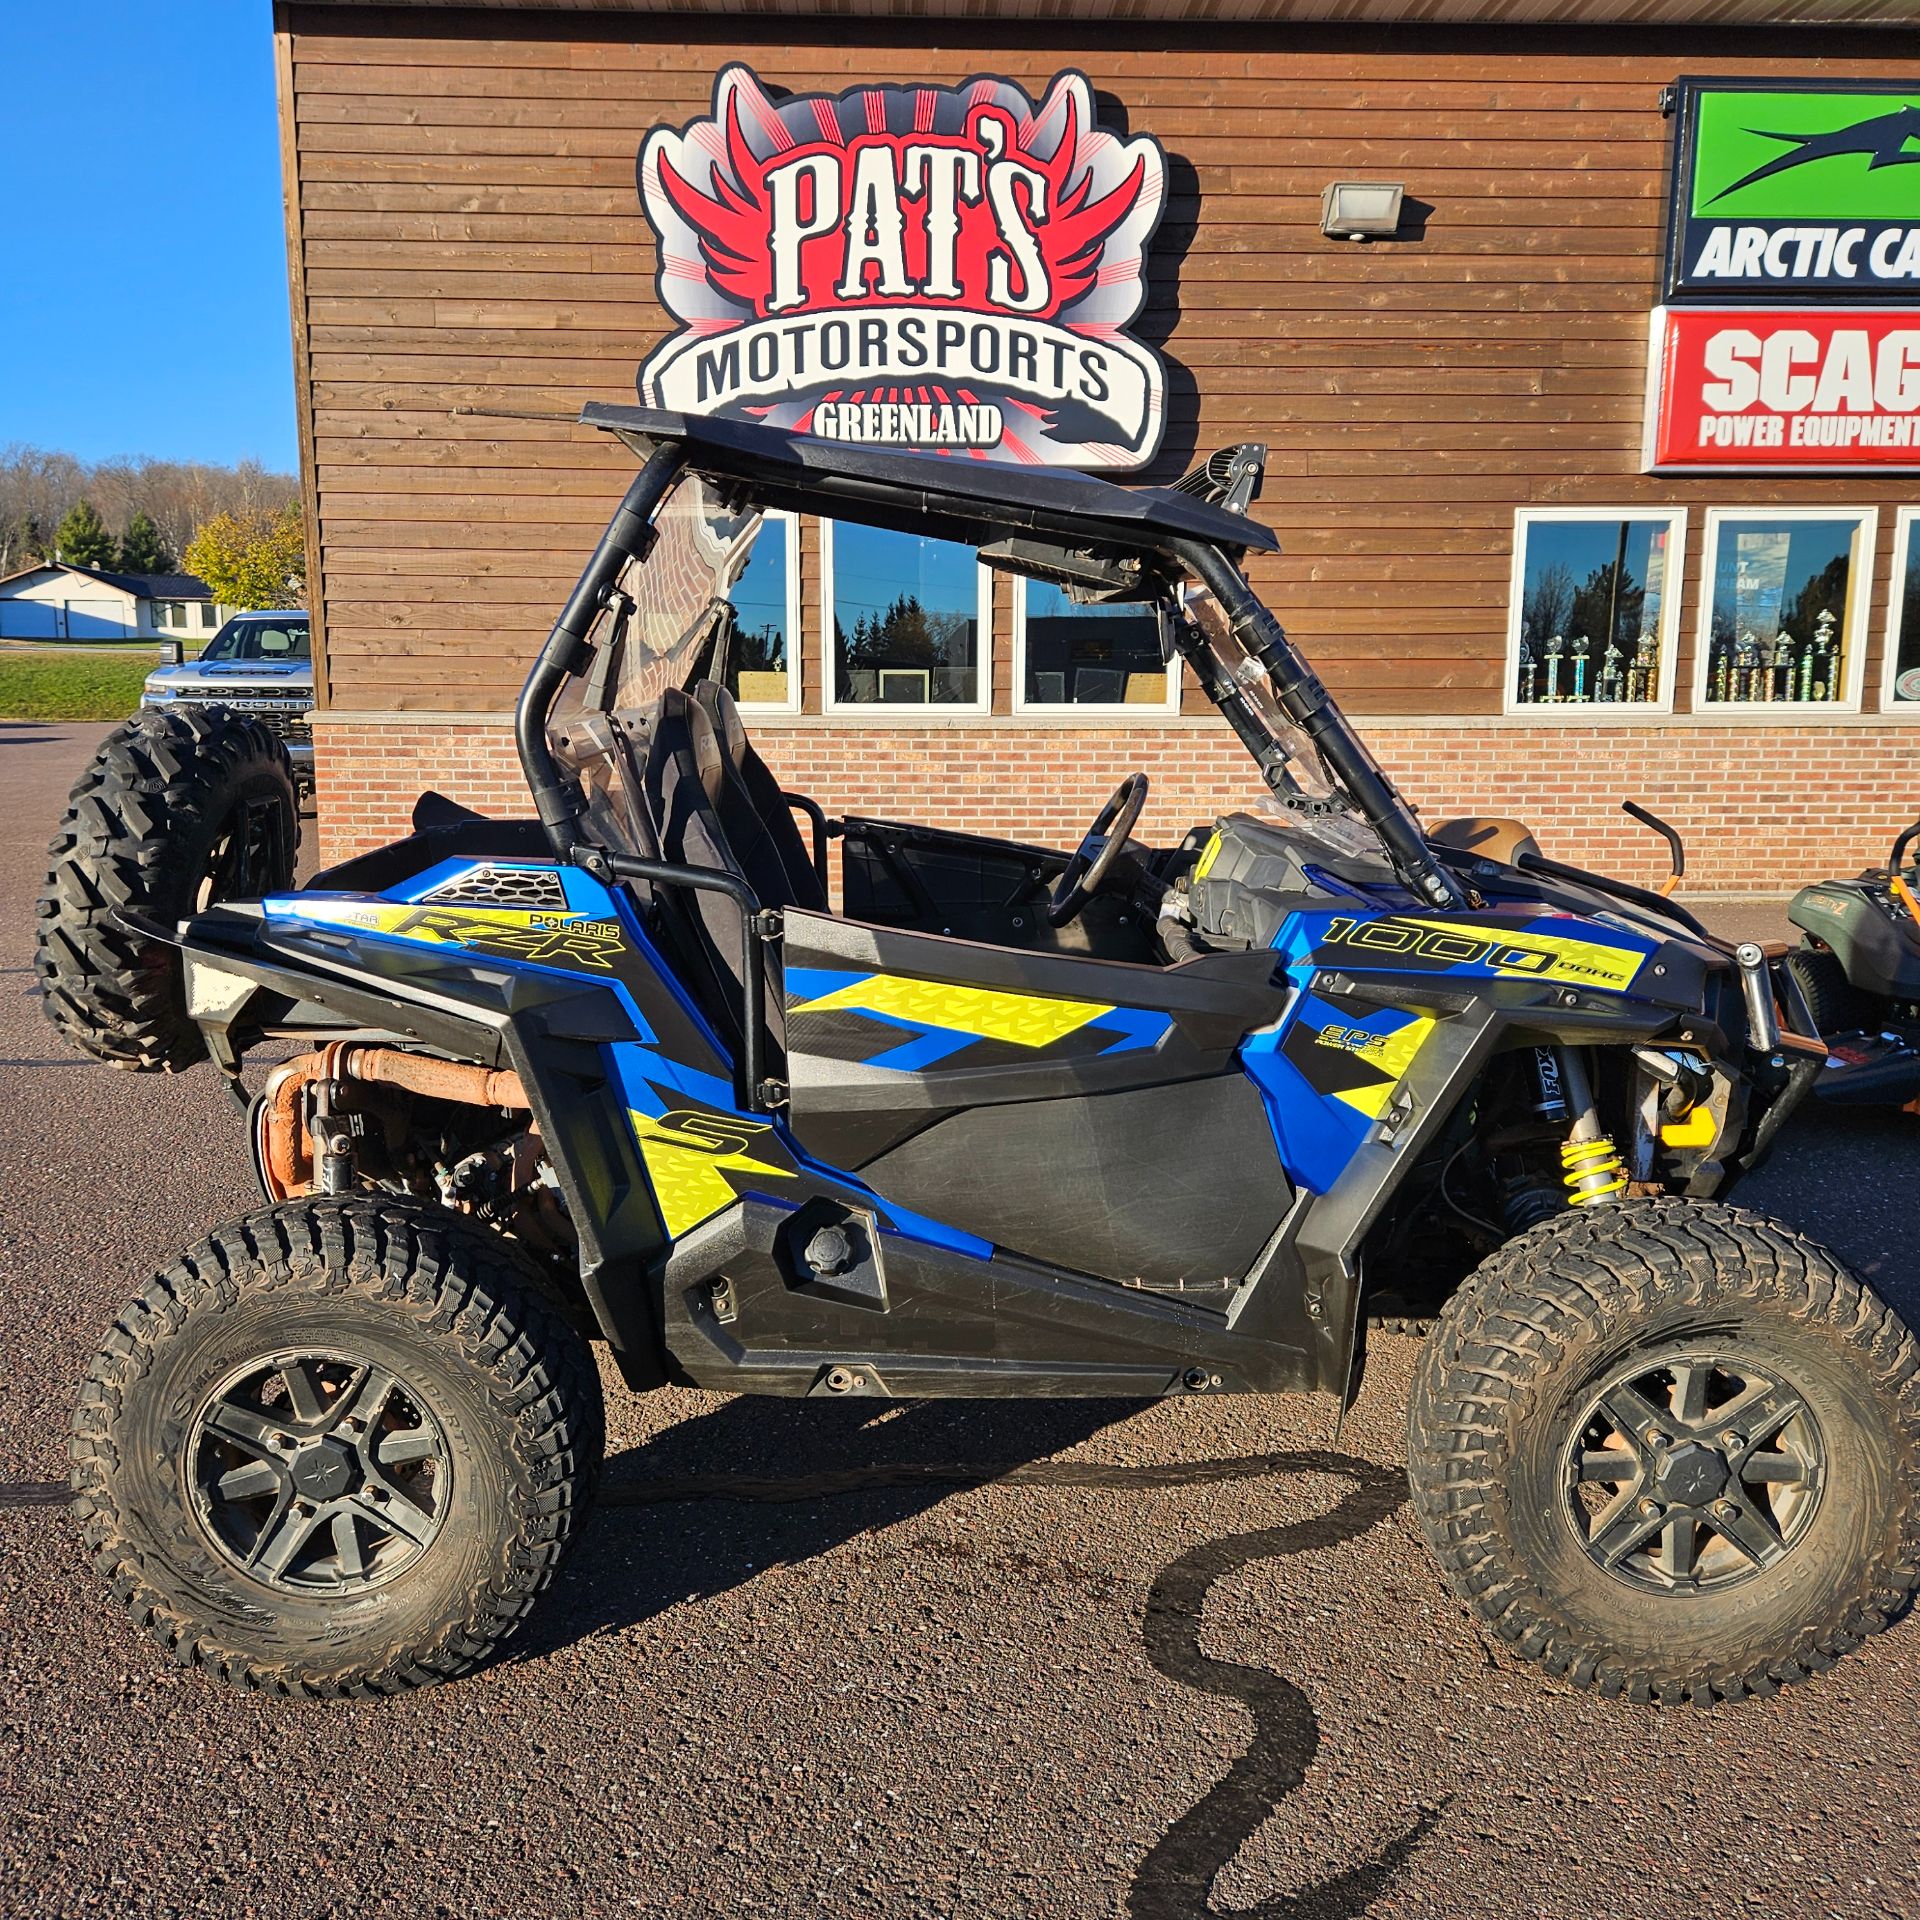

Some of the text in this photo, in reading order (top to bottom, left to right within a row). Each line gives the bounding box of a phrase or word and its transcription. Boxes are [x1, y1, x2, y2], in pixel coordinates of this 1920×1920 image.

[767, 116, 1047, 312] PAT'S
[1692, 226, 1866, 278] ARCTIC
[697, 317, 1109, 403] MOTORSPORTS
[1702, 329, 1920, 412] SCAG
[815, 402, 1002, 443] GREENLAND
[1699, 415, 1920, 447] POWER EQUIPMENT
[389, 908, 626, 968] RZR
[529, 914, 620, 938] POLARIS
[1321, 917, 1560, 975] 1000
[1320, 1024, 1390, 1047] EPS
[1534, 1044, 1560, 1095] FOX
